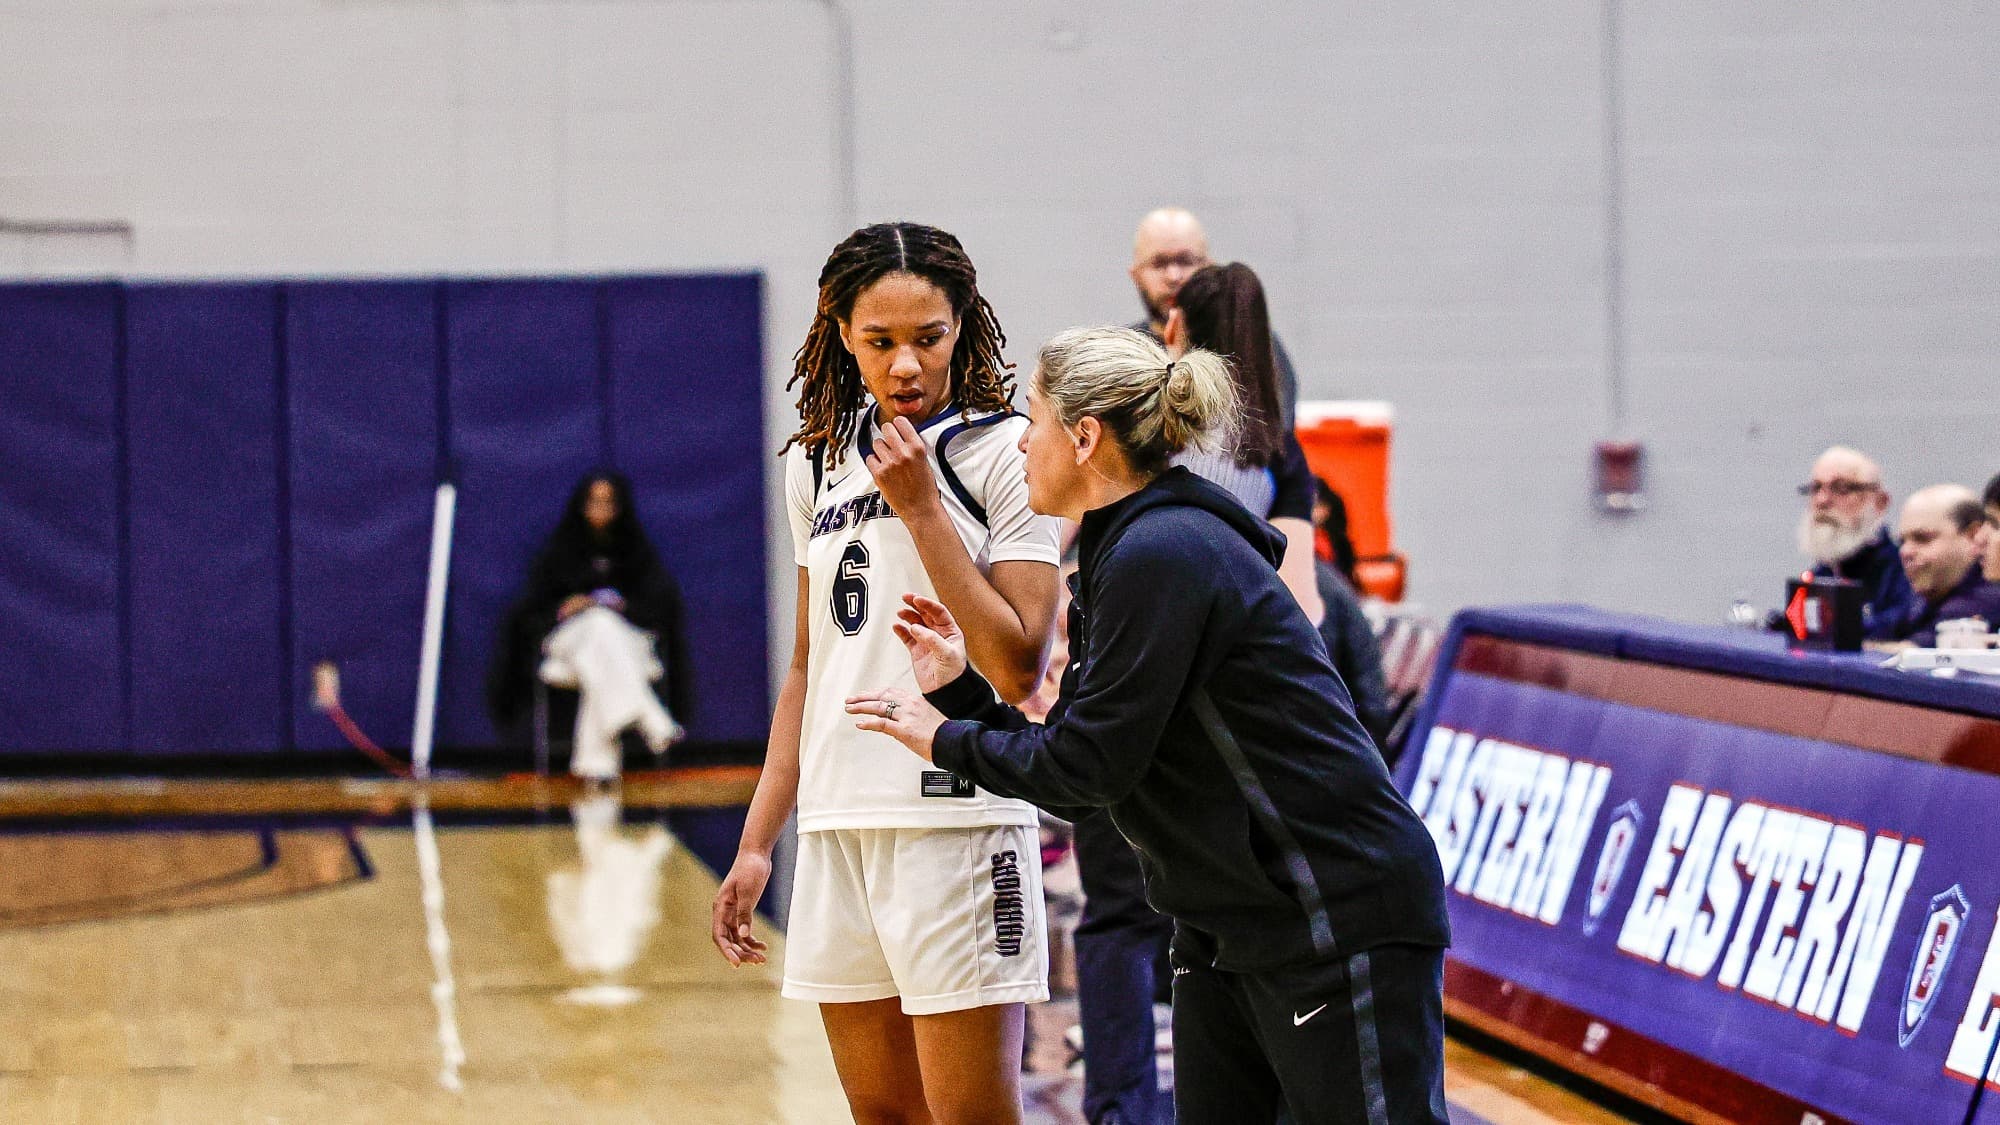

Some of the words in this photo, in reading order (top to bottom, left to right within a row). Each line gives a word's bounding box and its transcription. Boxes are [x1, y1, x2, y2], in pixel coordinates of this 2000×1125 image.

[830, 540, 869, 636] 6
[959, 779, 969, 790] M
[990, 850, 1025, 957] WARRIORS
[1617, 781, 1924, 1038] EASTERN
